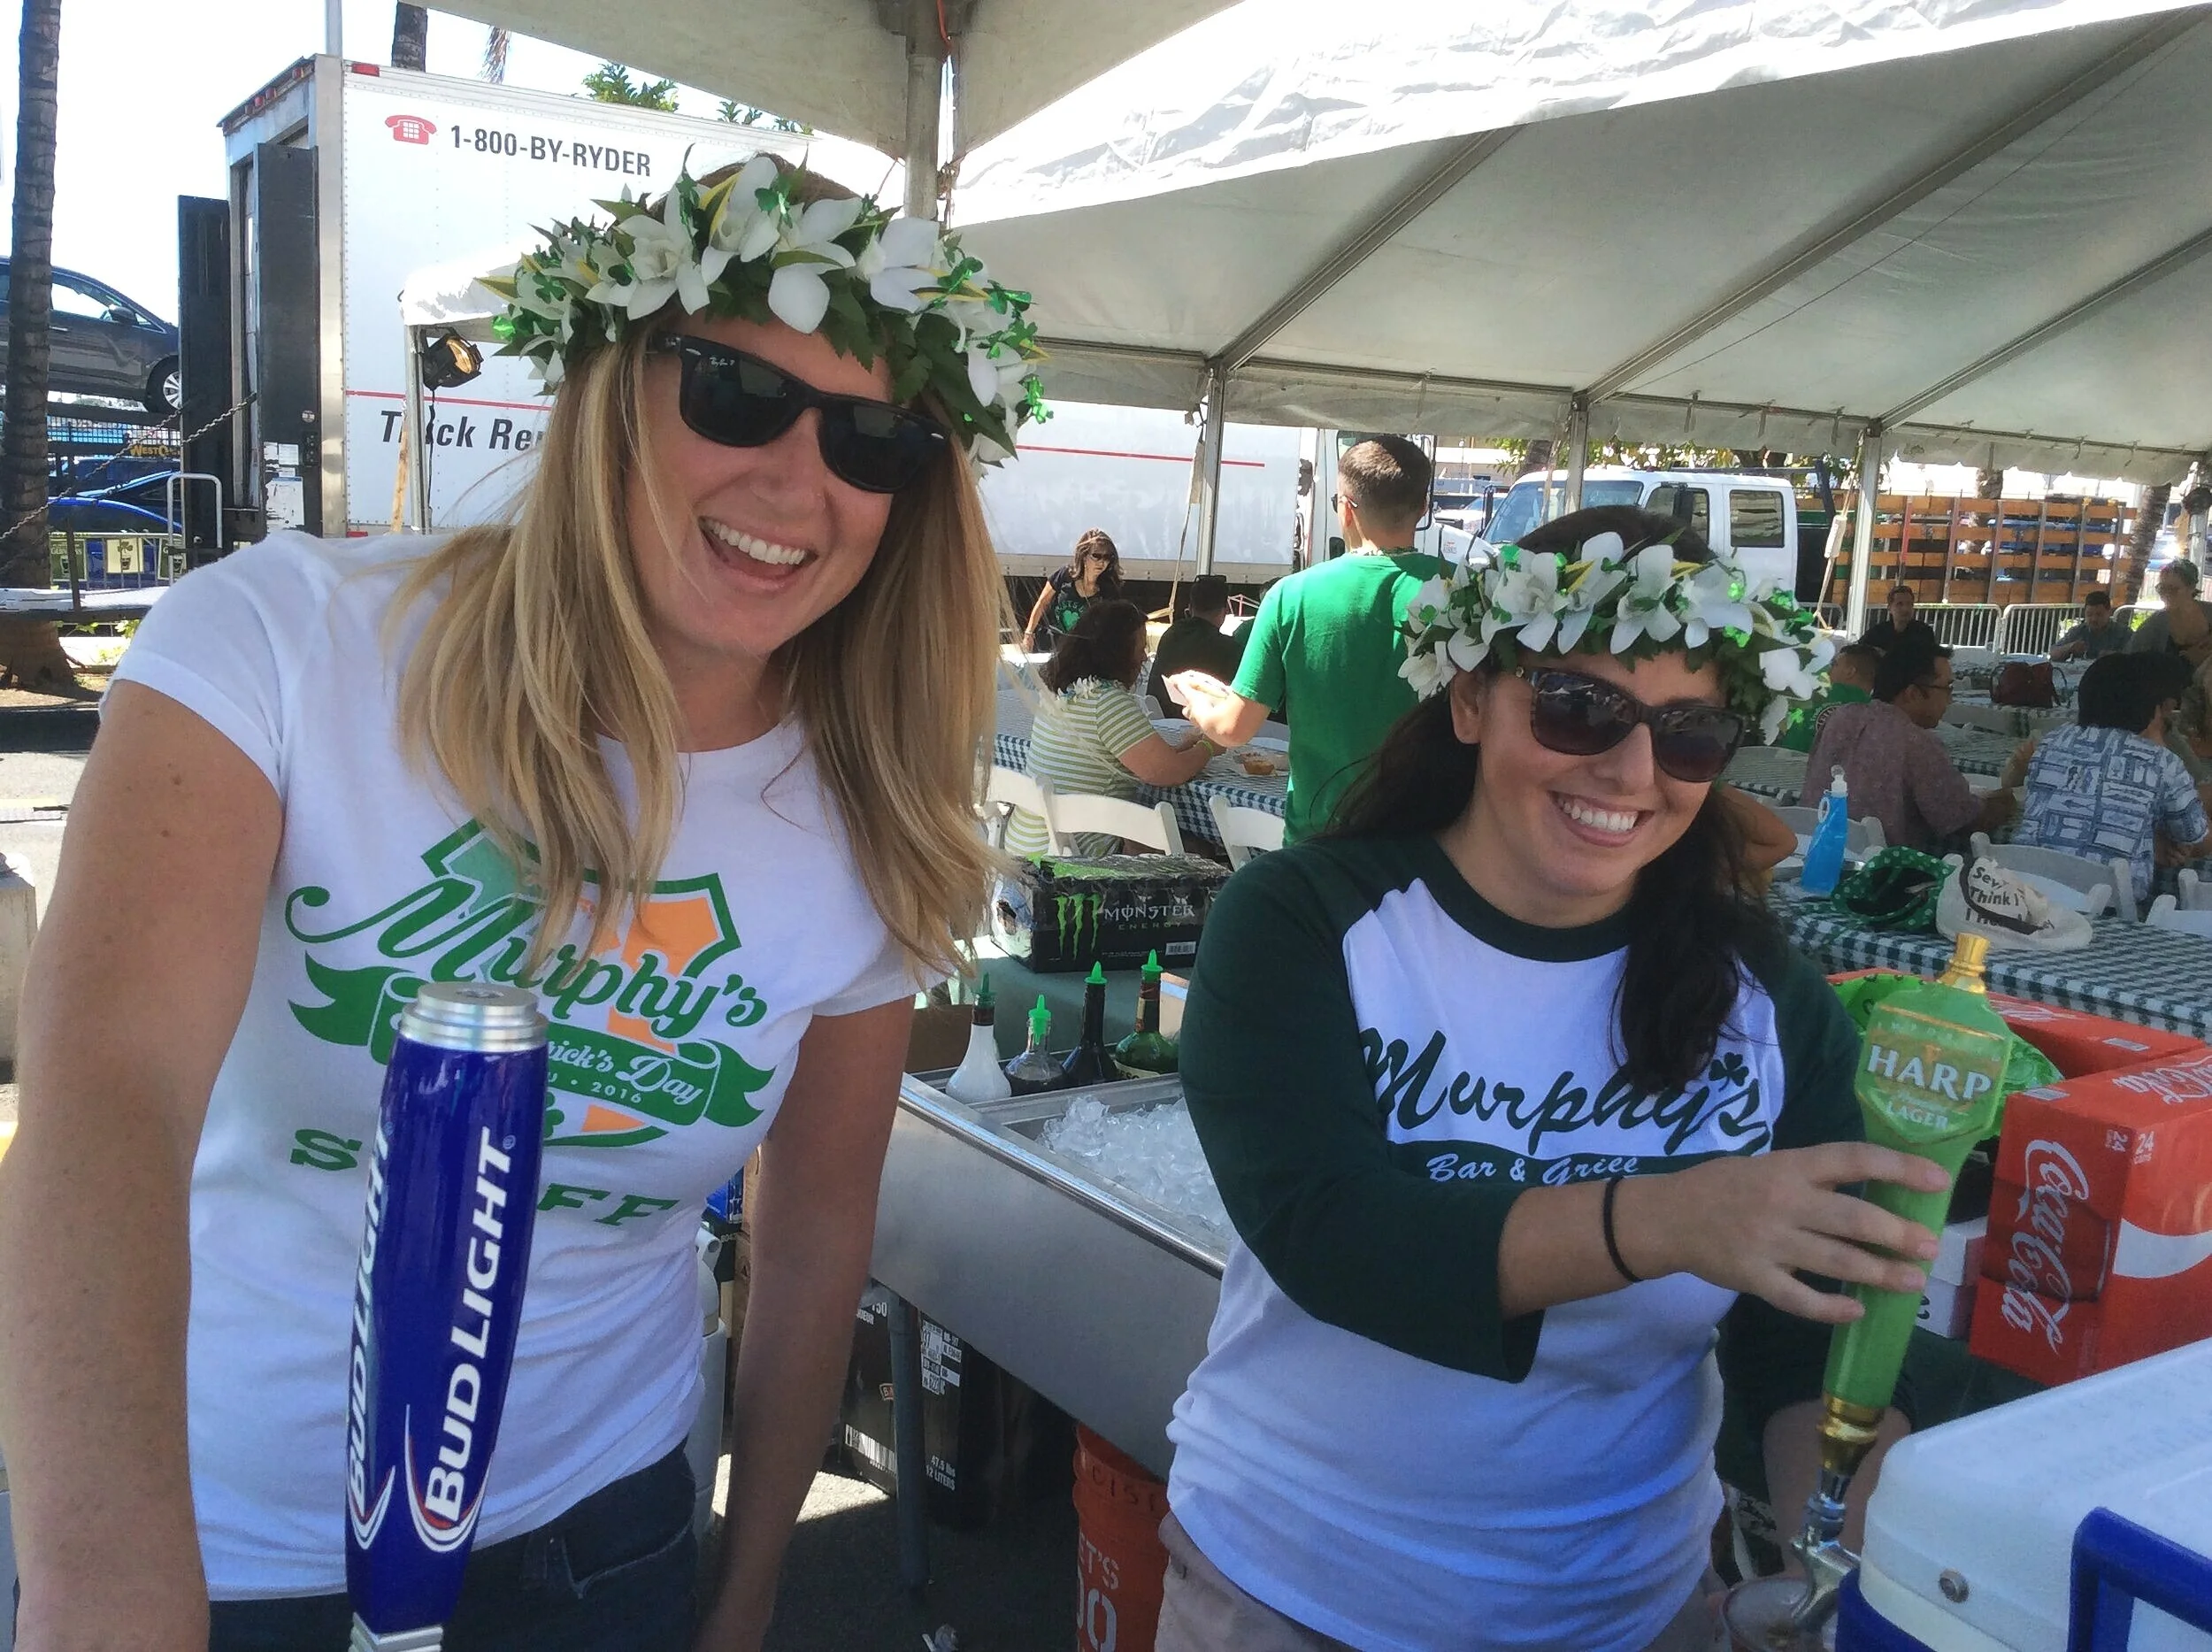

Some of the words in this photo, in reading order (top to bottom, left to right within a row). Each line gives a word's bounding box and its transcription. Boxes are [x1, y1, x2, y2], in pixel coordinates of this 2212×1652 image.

[451, 126, 650, 176] 1-800-BY-RYDER
[381, 411, 476, 448] Tck
[1104, 903, 1195, 921] MONSTER
[1970, 886, 2011, 906] Think
[285, 874, 767, 1038] Murphy's
[591, 1081, 641, 1103] 2016
[615, 1056, 703, 1105] Day
[1359, 1026, 1770, 1156] Murphy's
[1867, 1044, 1992, 1101] HARP
[1886, 1100, 1948, 1130] LAGER
[2136, 1131, 2154, 1154] 24
[1426, 1153, 1497, 1182] Bar
[1509, 1157, 1525, 1182] &
[1542, 1157, 1639, 1187] Grill
[450, 1126, 511, 1358] LIGHT
[2001, 1139, 2089, 1356] Coca-Cola
[349, 1345, 367, 1518] BUD
[425, 1364, 480, 1522] BUD
[926, 1464, 933, 1479] 12
[933, 1471, 956, 1491] LITERS
[1079, 1532, 1119, 1590] ET'S
